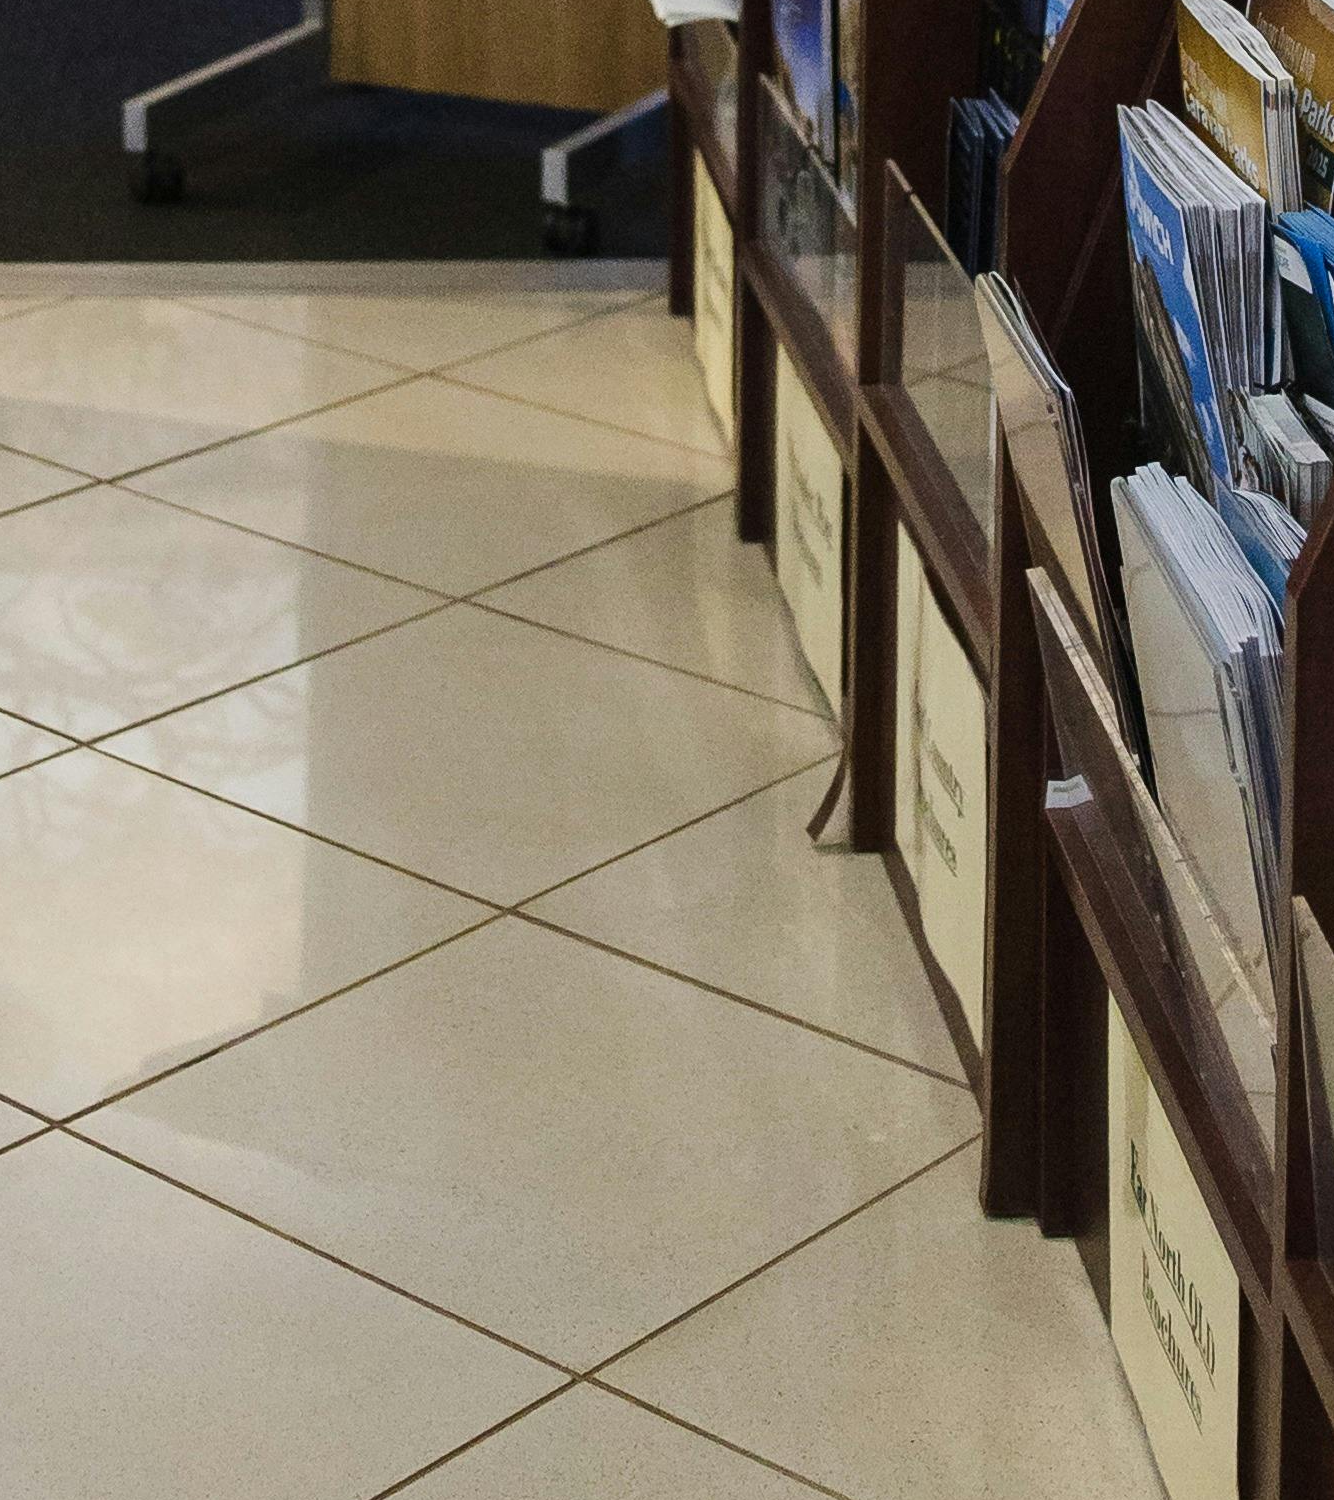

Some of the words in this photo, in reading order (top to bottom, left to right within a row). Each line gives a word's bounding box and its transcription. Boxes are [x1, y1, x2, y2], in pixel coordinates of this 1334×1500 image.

[1130, 1138, 1147, 1218] Far
[1149, 1190, 1186, 1305] North
[1188, 1280, 1216, 1378] QLD
[1141, 1245, 1204, 1428] Brochures
